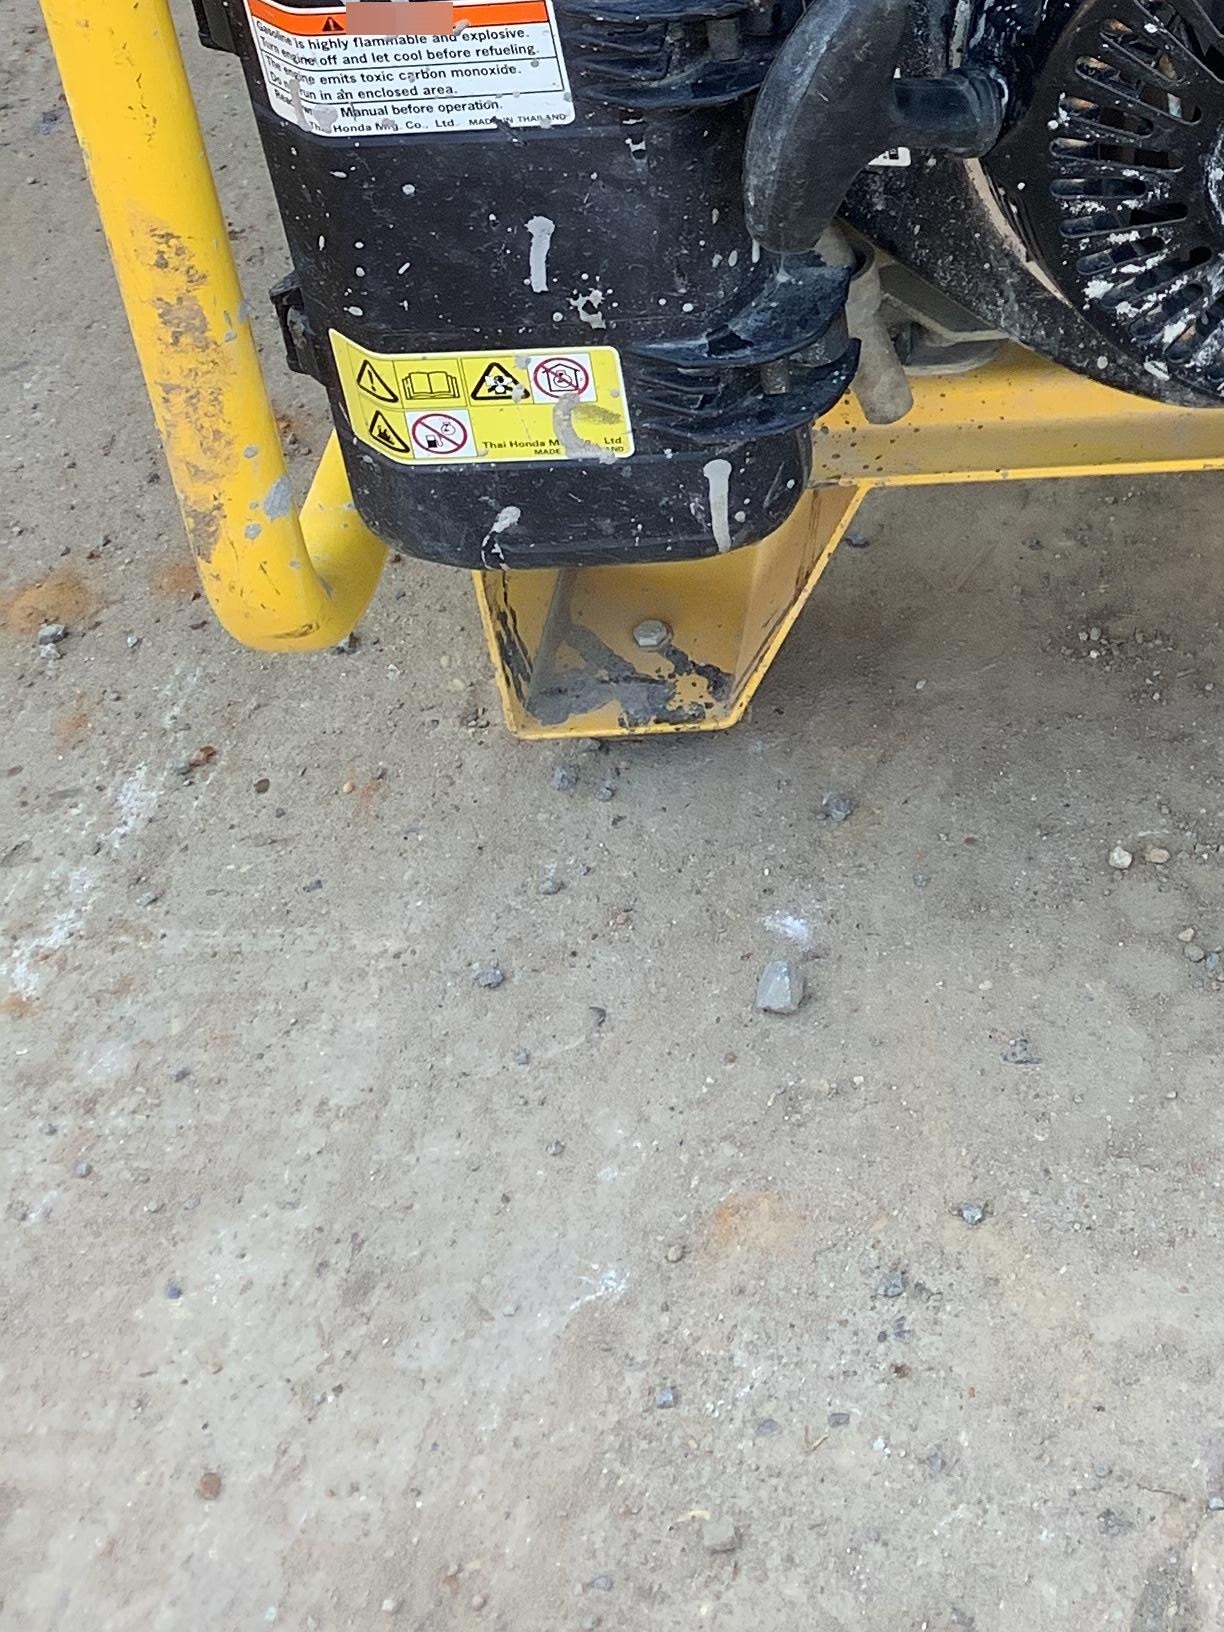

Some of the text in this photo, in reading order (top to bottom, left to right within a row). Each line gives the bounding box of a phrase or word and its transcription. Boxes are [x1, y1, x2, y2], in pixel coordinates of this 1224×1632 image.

[256, 20, 293, 46] Gasoline
[295, 37, 305, 49] is
[308, 37, 350, 51] highly
[462, 28, 530, 43] explosive.
[319, 54, 338, 66] off
[343, 53, 368, 65] and
[371, 52, 389, 63] let
[394, 50, 423, 62] cool
[427, 48, 471, 60] before
[475, 44, 540, 57] refueling.
[265, 55, 281, 71] The
[320, 73, 358, 85] emits
[361, 71, 395, 83] toxic
[451, 65, 522, 79] monoxide.
[320, 89, 332, 101] in
[336, 90, 354, 100] an
[358, 86, 418, 99] enclosed
[423, 86, 458, 97] area.
[340, 105, 389, 118] Manual
[392, 102, 434, 115] before
[438, 100, 503, 114] operation.
[333, 122, 372, 133] Honda
[468, 116, 496, 126] MAD
[482, 440, 507, 449] Thai
[509, 439, 546, 448] Honda
